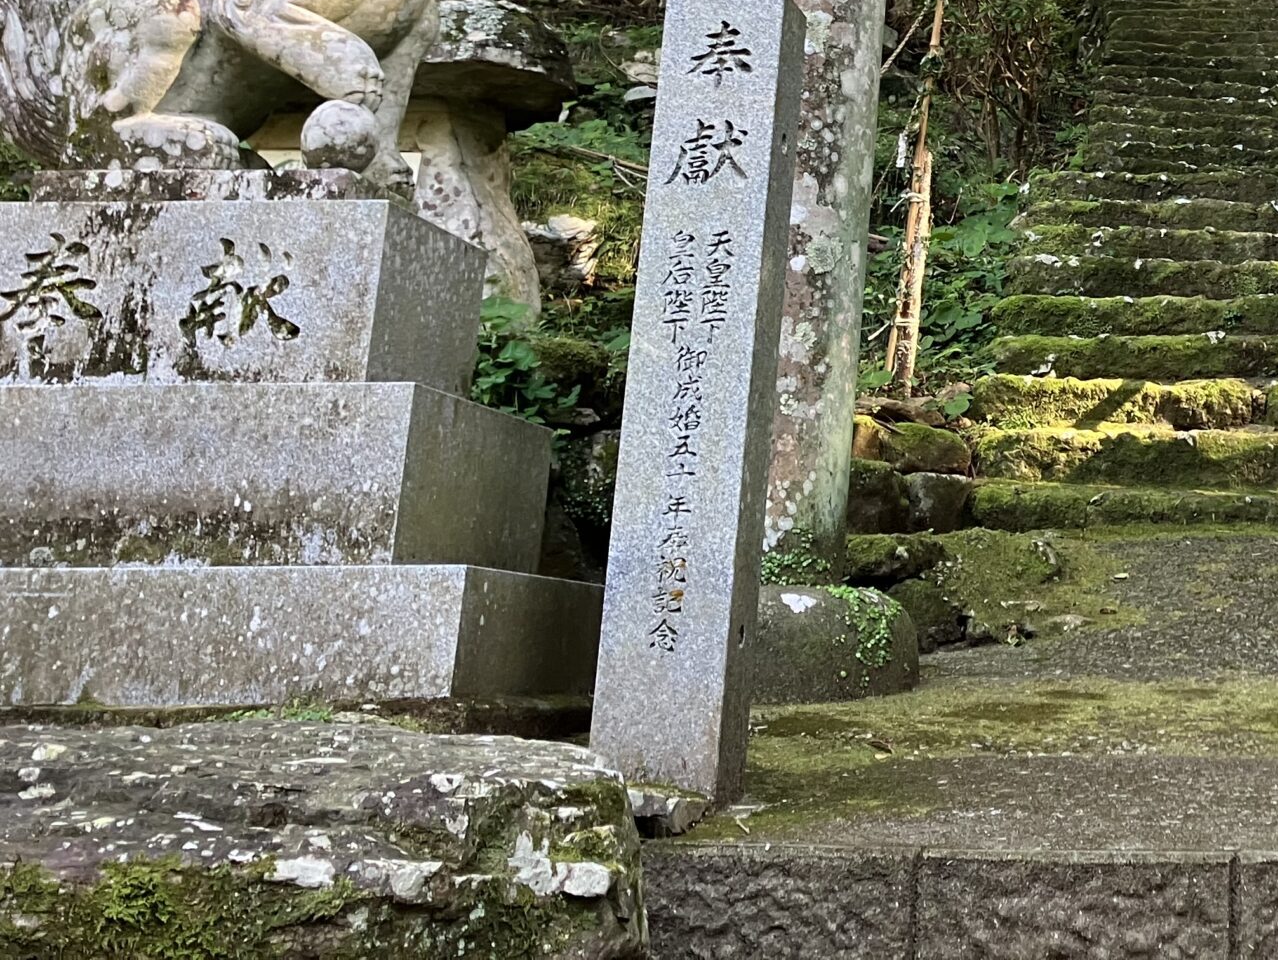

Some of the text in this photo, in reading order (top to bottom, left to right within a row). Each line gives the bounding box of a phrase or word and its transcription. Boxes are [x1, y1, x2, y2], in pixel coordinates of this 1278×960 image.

[0, 232, 301, 356] 奉献
[662, 230, 696, 344] 皇后陛下
[699, 230, 735, 344] 天皇陛下
